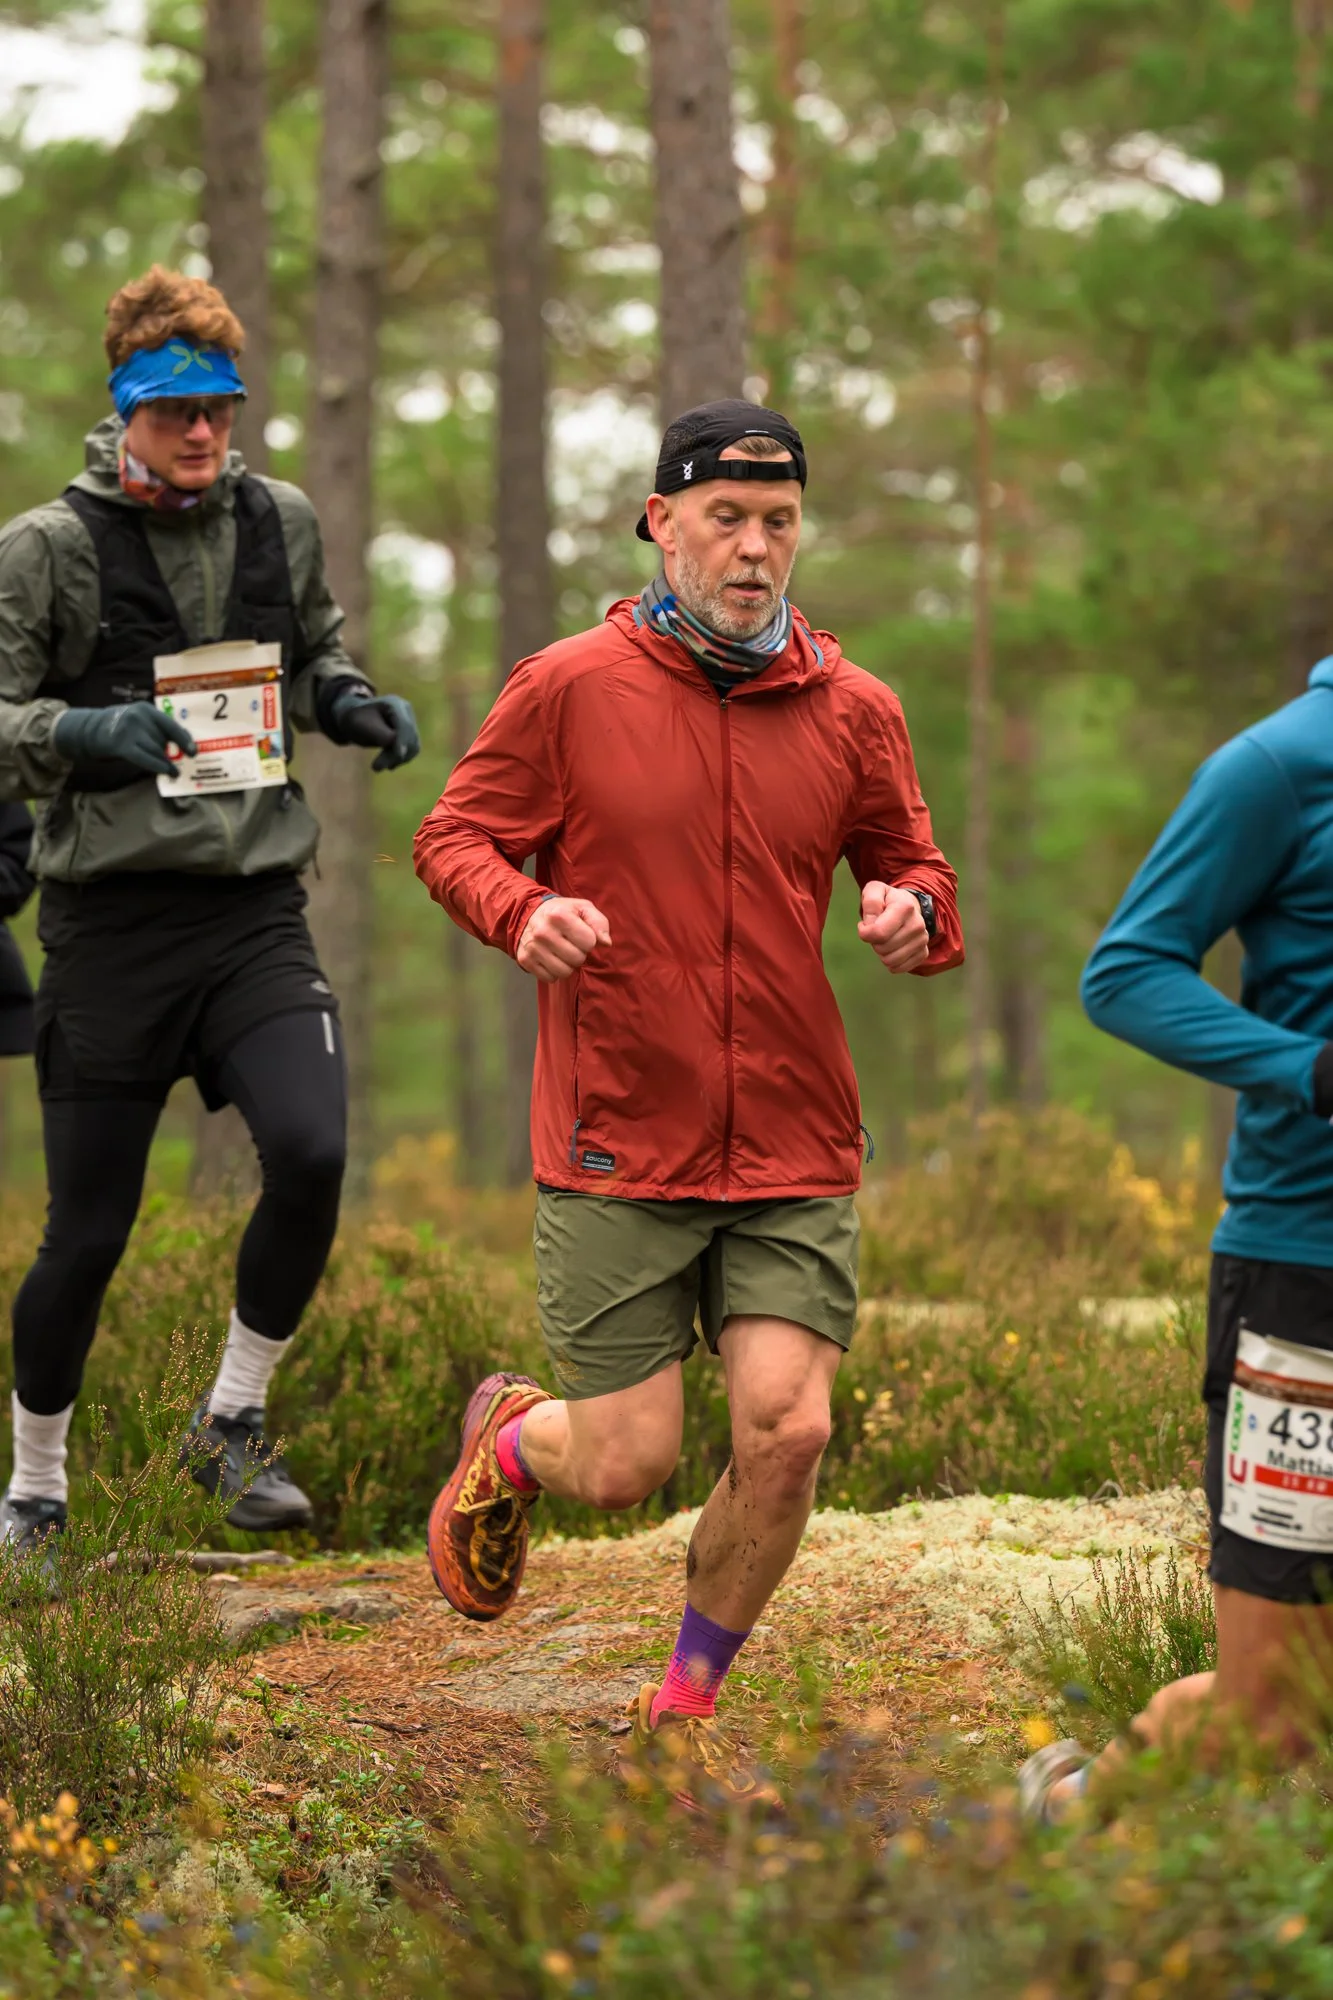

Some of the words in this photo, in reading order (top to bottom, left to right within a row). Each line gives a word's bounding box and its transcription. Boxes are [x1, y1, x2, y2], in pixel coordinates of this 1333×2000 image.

[213, 693, 229, 720] 2
[585, 1155, 612, 1165] saucony
[1268, 1408, 1333, 1453] 43
[453, 1445, 486, 1512] HOKA
